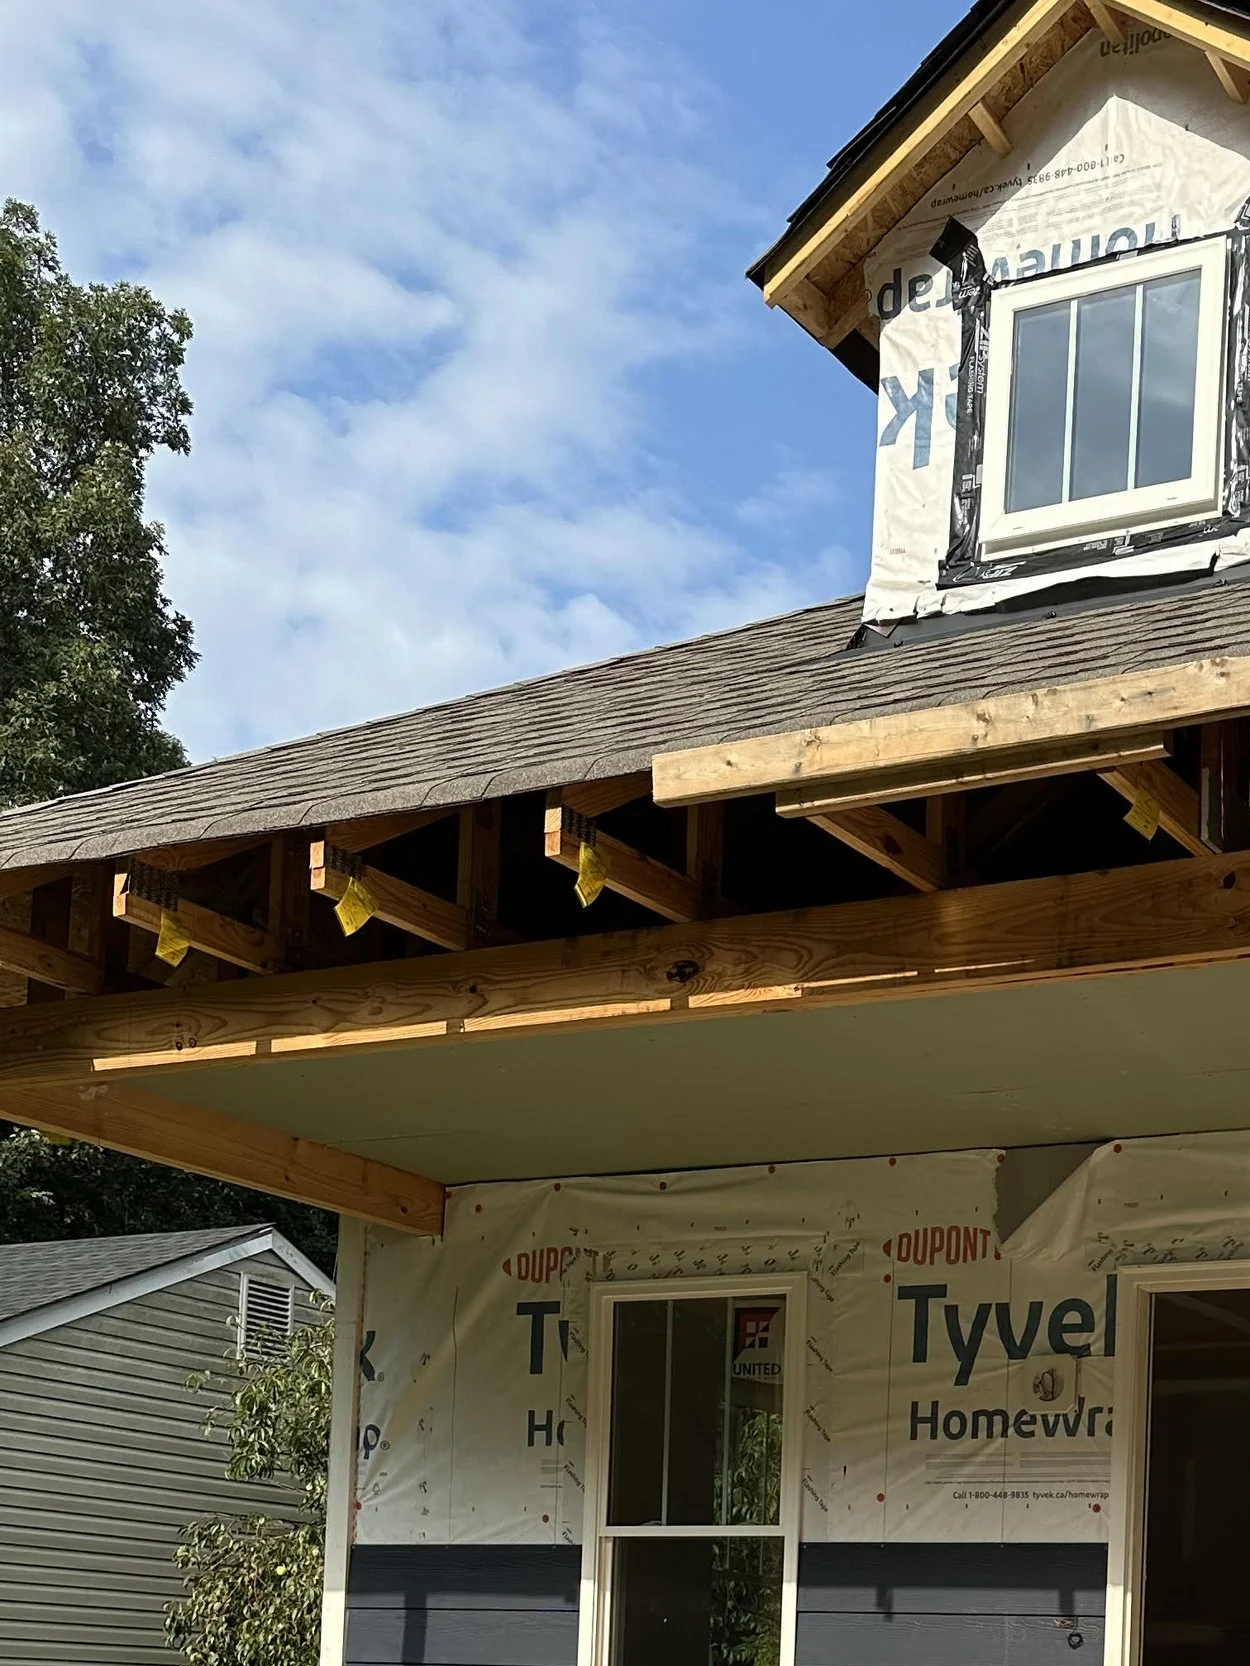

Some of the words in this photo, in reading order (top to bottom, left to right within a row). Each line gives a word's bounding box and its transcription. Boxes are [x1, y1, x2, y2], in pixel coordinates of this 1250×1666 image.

[897, 1225, 991, 1266] DUPONT
[733, 1363, 781, 1376] UNITED
[952, 1490, 967, 1500] Call
[968, 1490, 1029, 1500] 1-800-448-9835
[1032, 1489, 1110, 1501] tyvek.ca/homewrap
